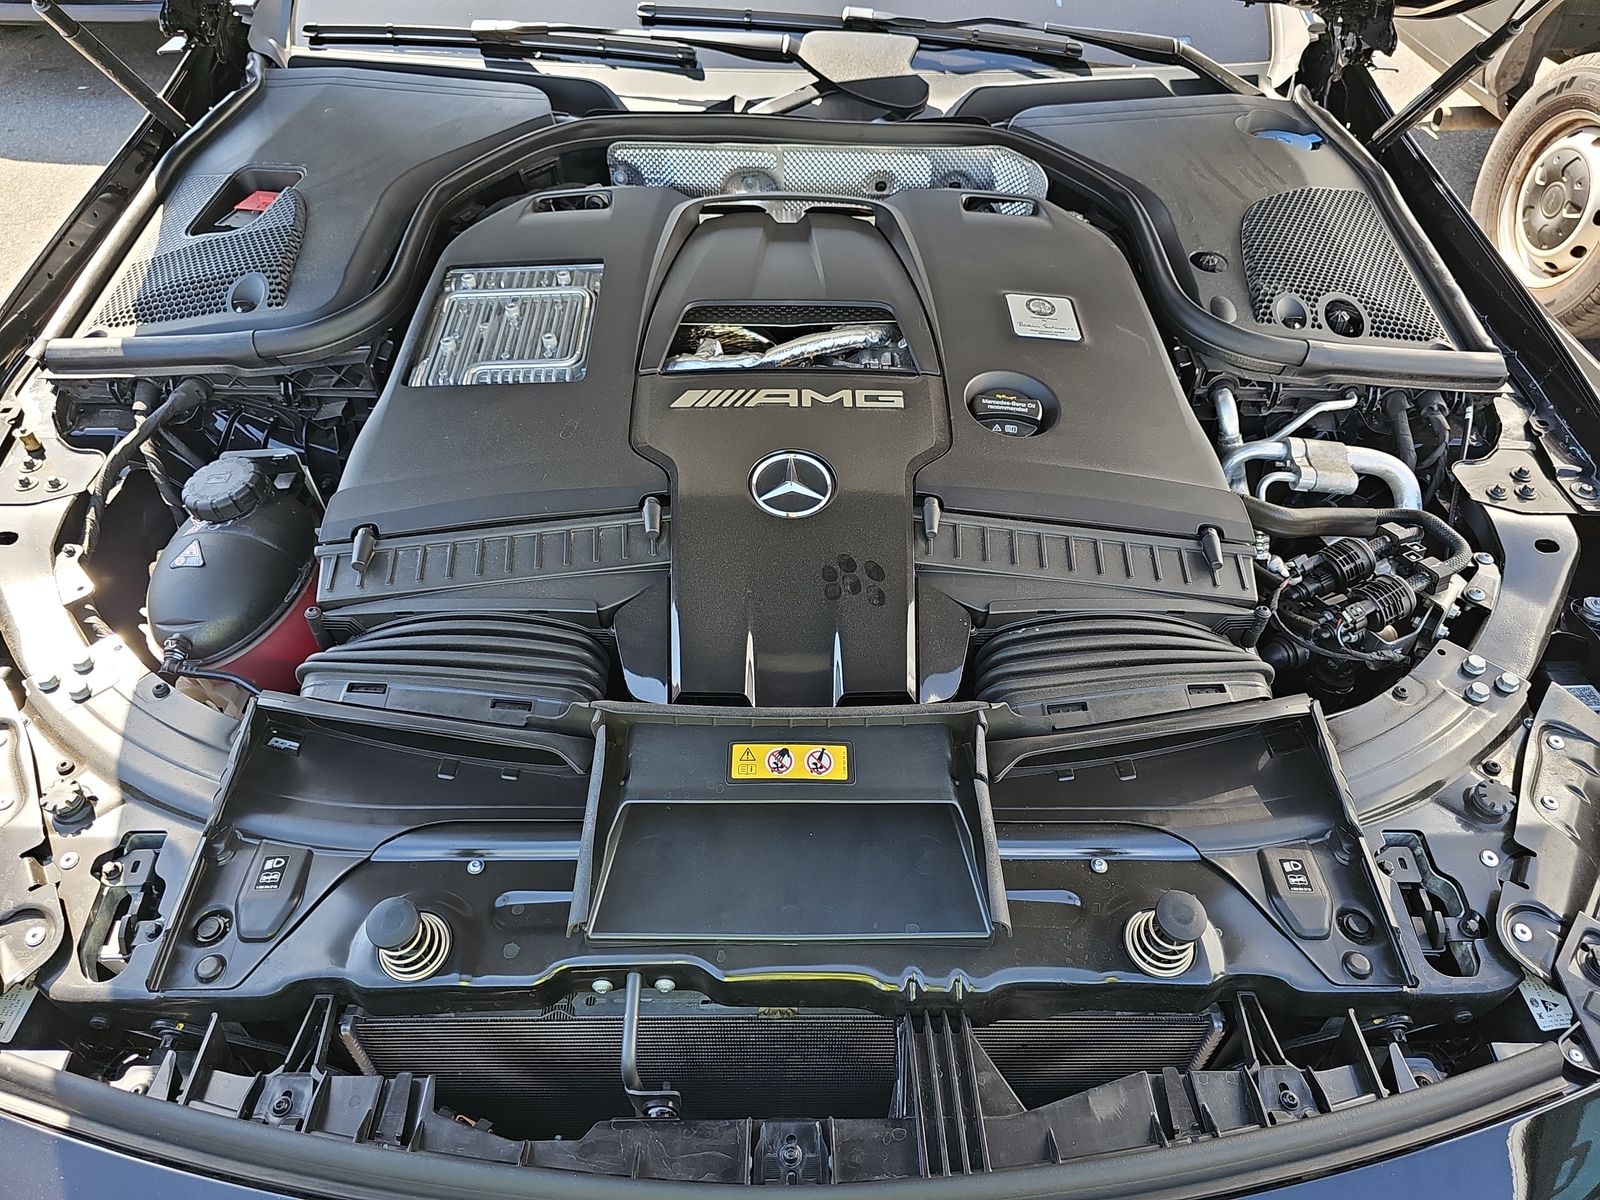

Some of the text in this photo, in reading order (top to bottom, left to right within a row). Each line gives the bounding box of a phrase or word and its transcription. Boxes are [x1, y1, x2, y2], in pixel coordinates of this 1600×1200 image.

[744, 388, 905, 409] AMG
[982, 398, 1026, 407] Mercedes-Benz
[987, 404, 1029, 413] recommended
